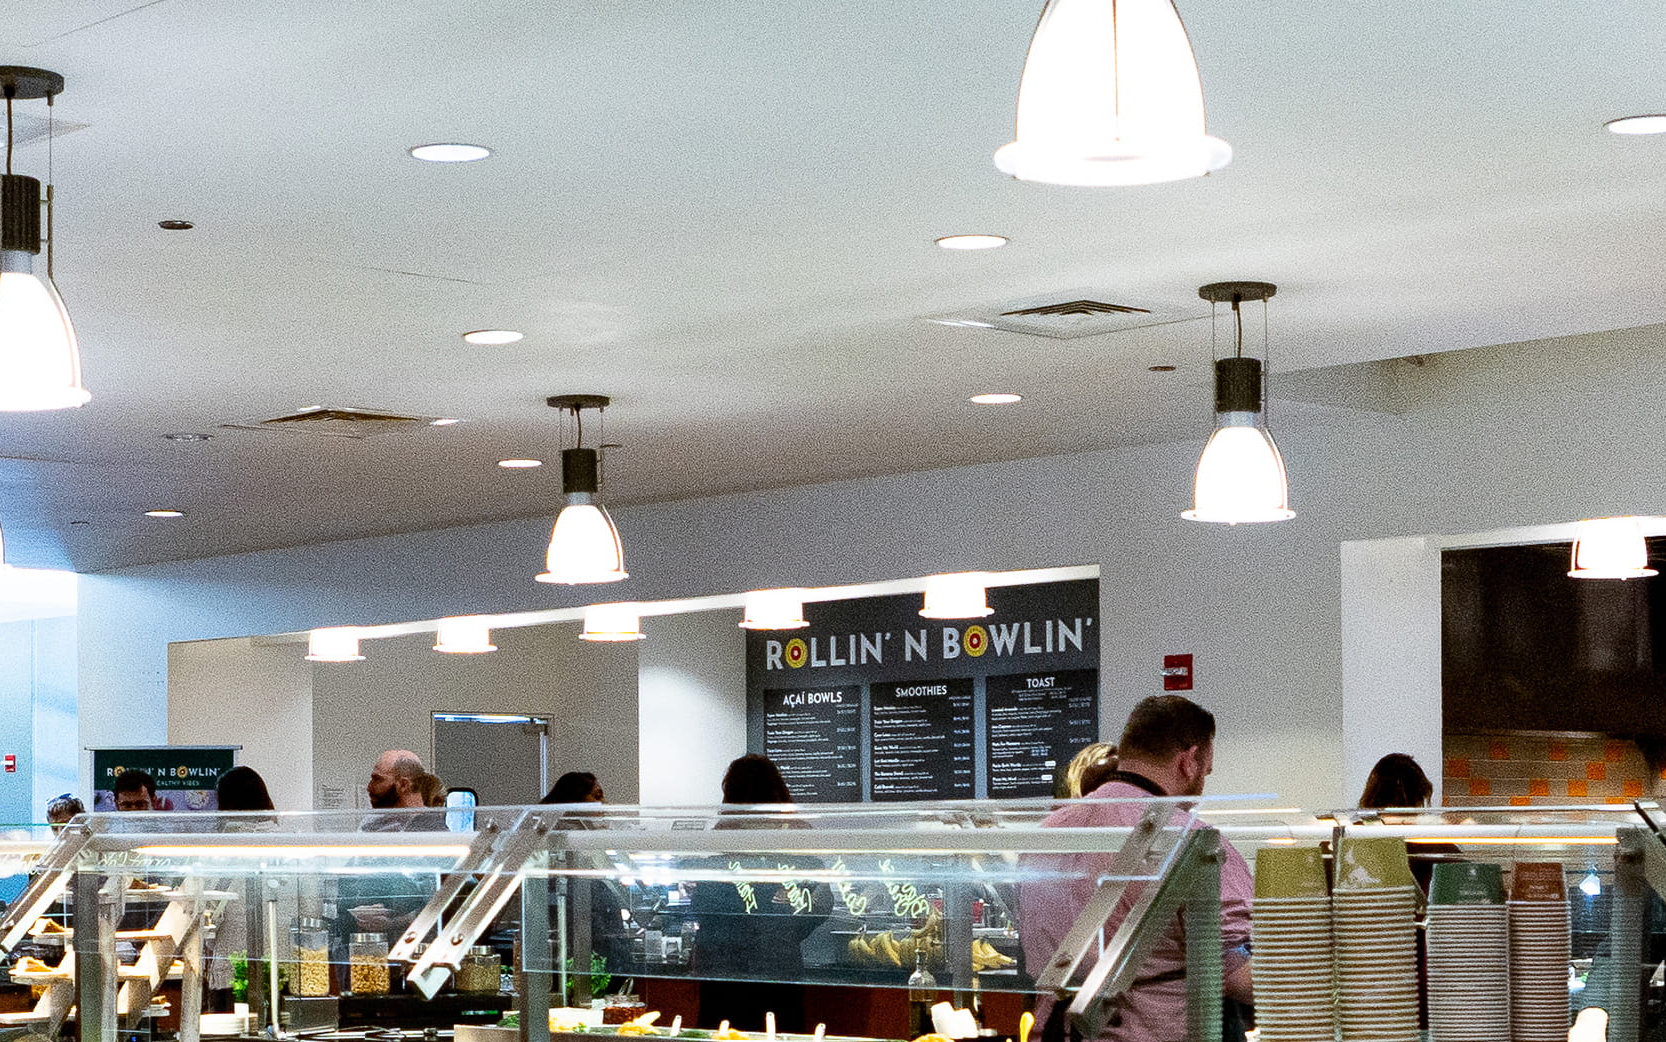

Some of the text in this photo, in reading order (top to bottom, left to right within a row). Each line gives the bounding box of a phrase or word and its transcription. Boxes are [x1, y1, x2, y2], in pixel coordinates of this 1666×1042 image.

[766, 617, 1092, 670] ROLLIN' N BOWLIN'
[1026, 677, 1055, 689] TOAST
[895, 685, 947, 698] SMOOTHIES
[782, 691, 842, 708] AÇAÍ BOWLS
[158, 767, 166, 777] N
[170, 765, 221, 778] BOWLIN'
